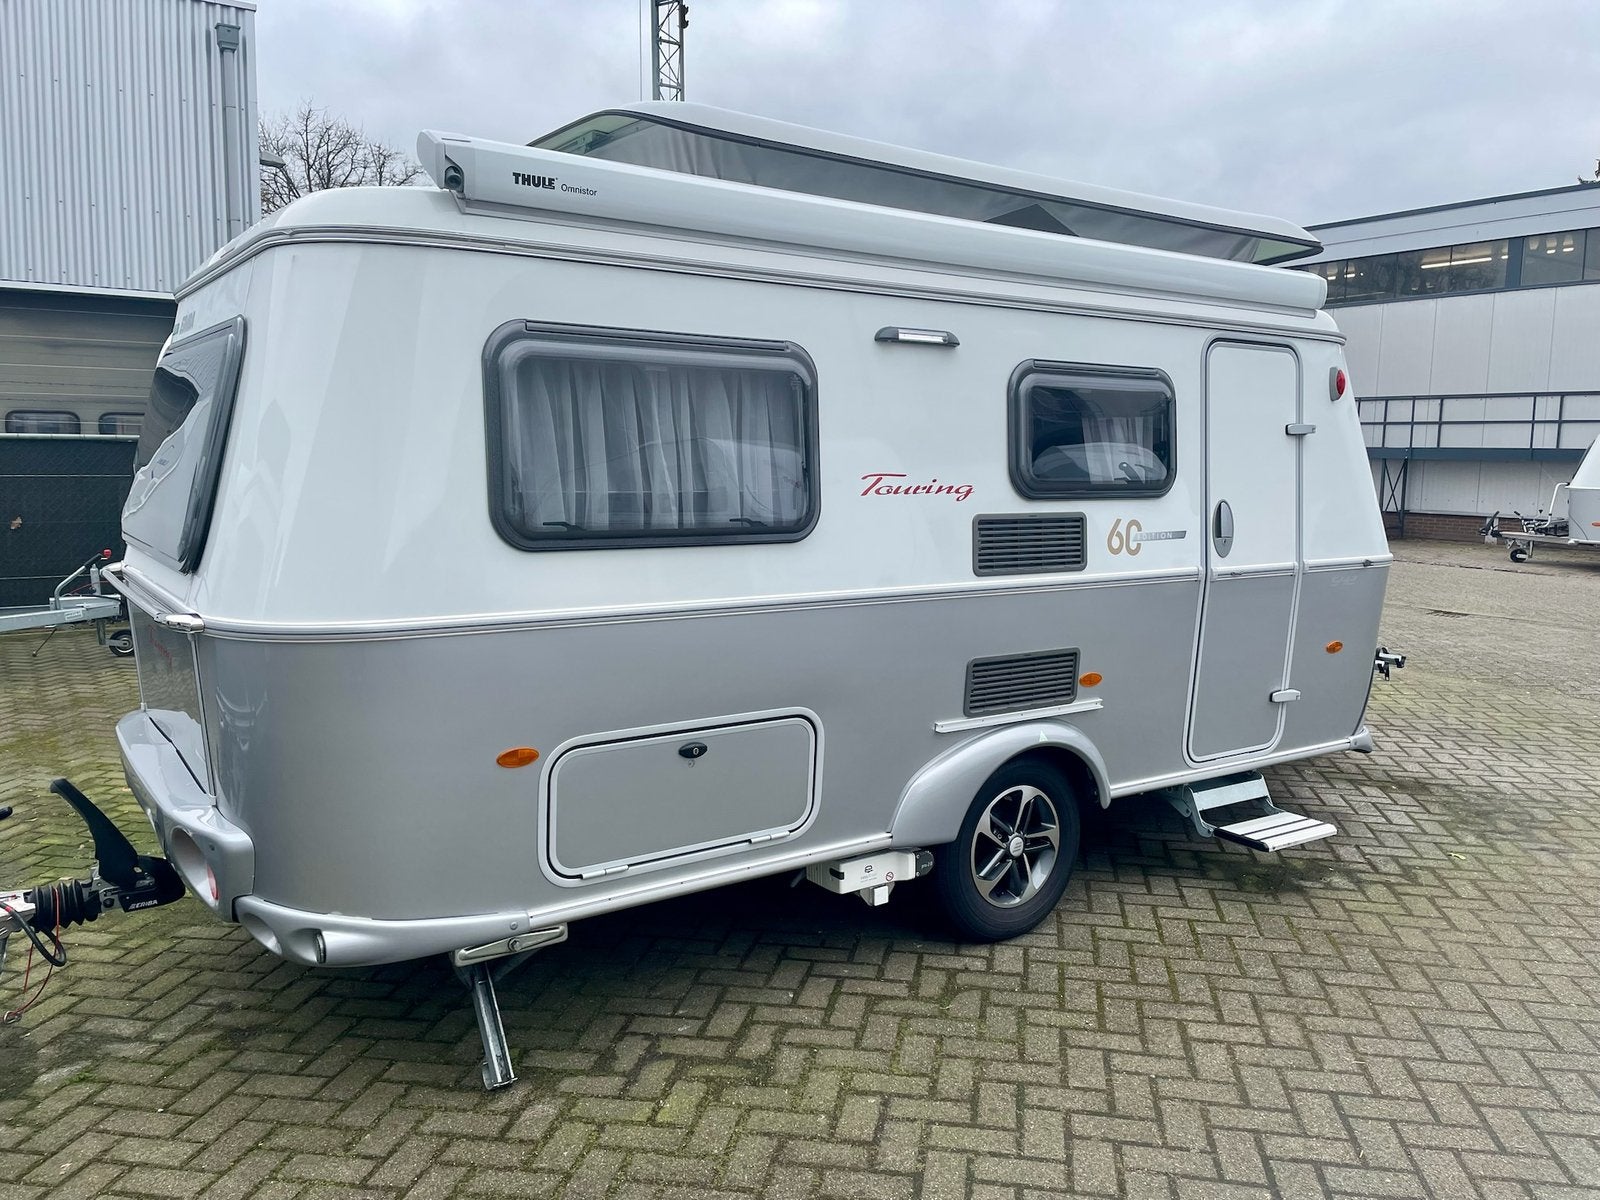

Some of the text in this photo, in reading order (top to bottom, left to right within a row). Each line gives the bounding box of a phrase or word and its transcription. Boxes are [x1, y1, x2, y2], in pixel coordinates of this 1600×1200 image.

[512, 171, 598, 196] THULE Omnistor
[860, 472, 975, 502] Touring
